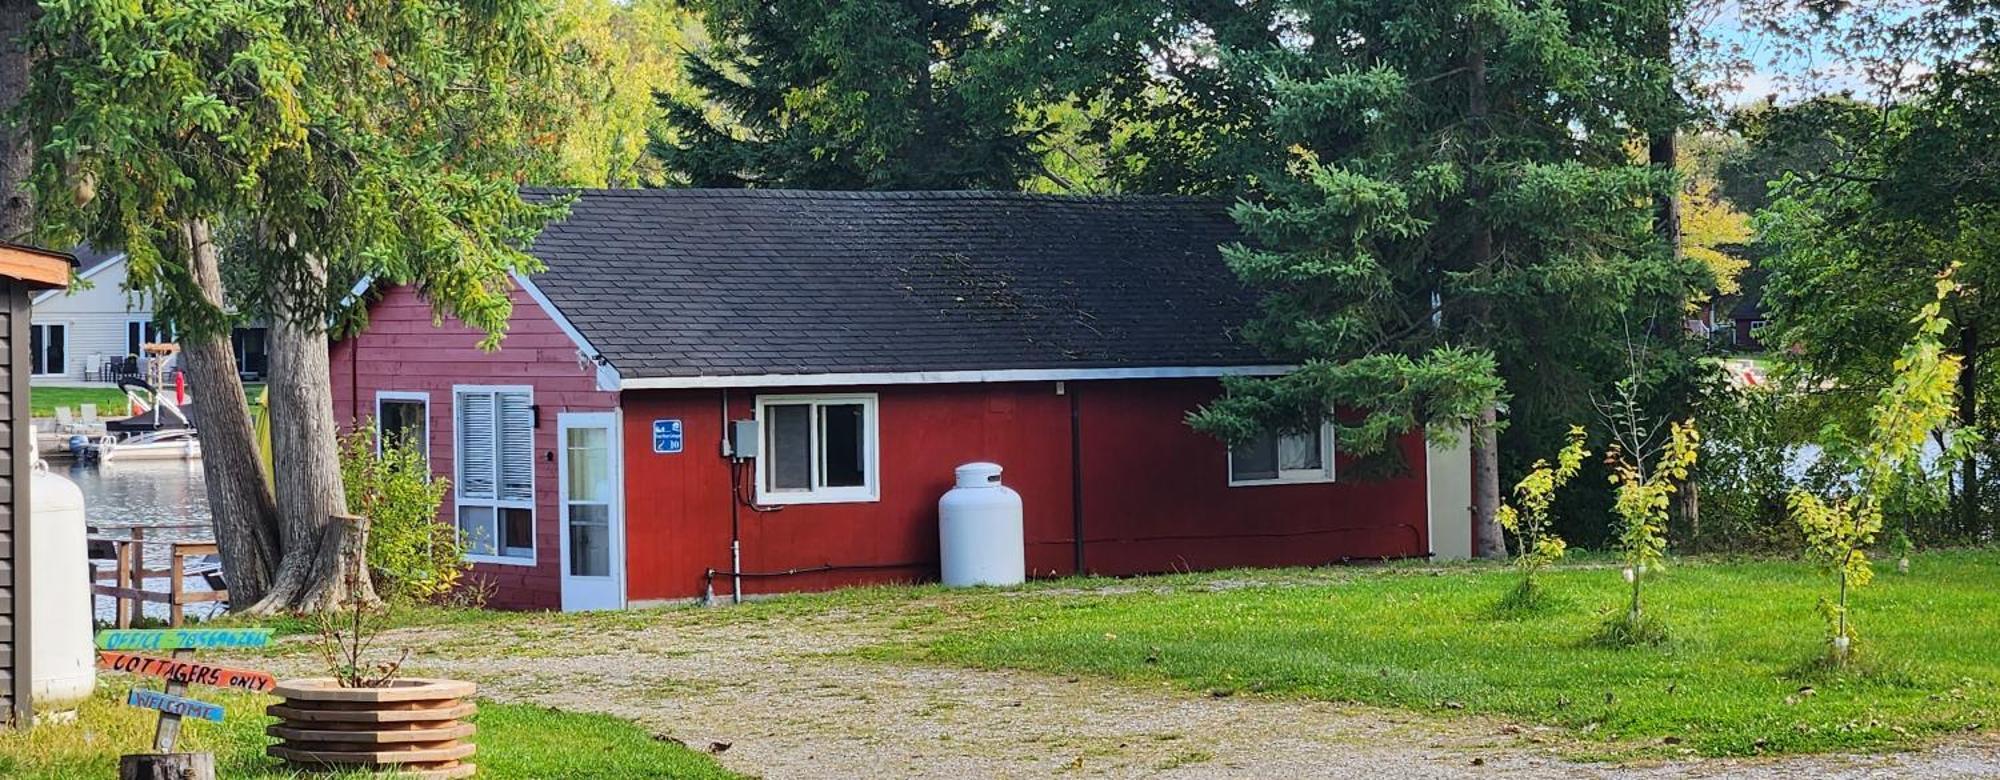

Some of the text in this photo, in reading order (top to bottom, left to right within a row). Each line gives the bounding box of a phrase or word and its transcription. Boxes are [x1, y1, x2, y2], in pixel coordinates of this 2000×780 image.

[107, 631, 163, 648] OFFICE
[113, 655, 267, 691] COTTAGERS ONLY
[137, 691, 213, 719] WELCOME
